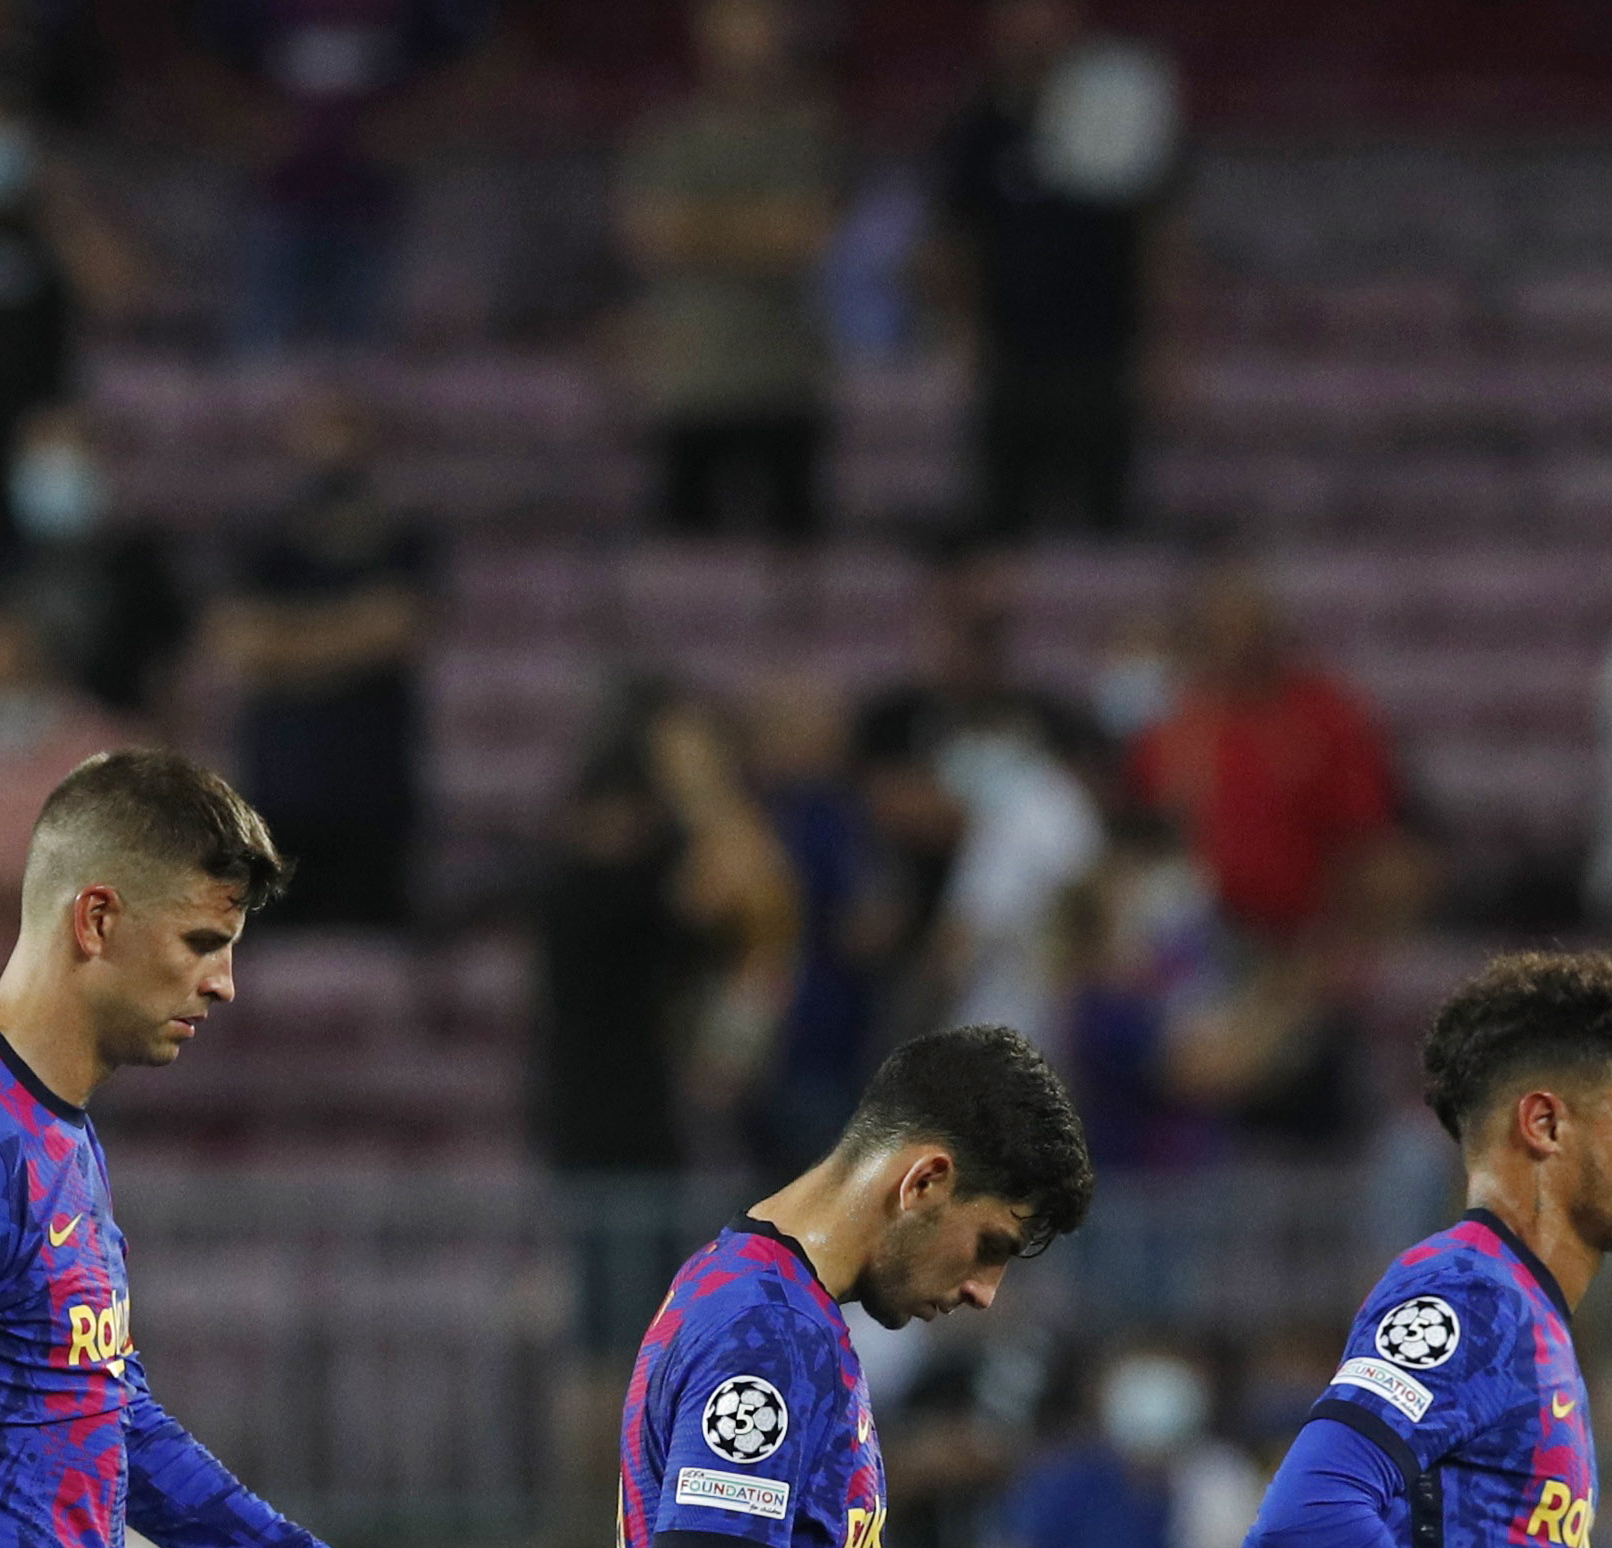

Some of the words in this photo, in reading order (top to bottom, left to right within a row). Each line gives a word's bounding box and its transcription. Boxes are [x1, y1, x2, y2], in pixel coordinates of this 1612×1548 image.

[1404, 1317, 1431, 1342] 5
[734, 1403, 755, 1435] 5
[680, 1479, 785, 1506] FOUNDATION
